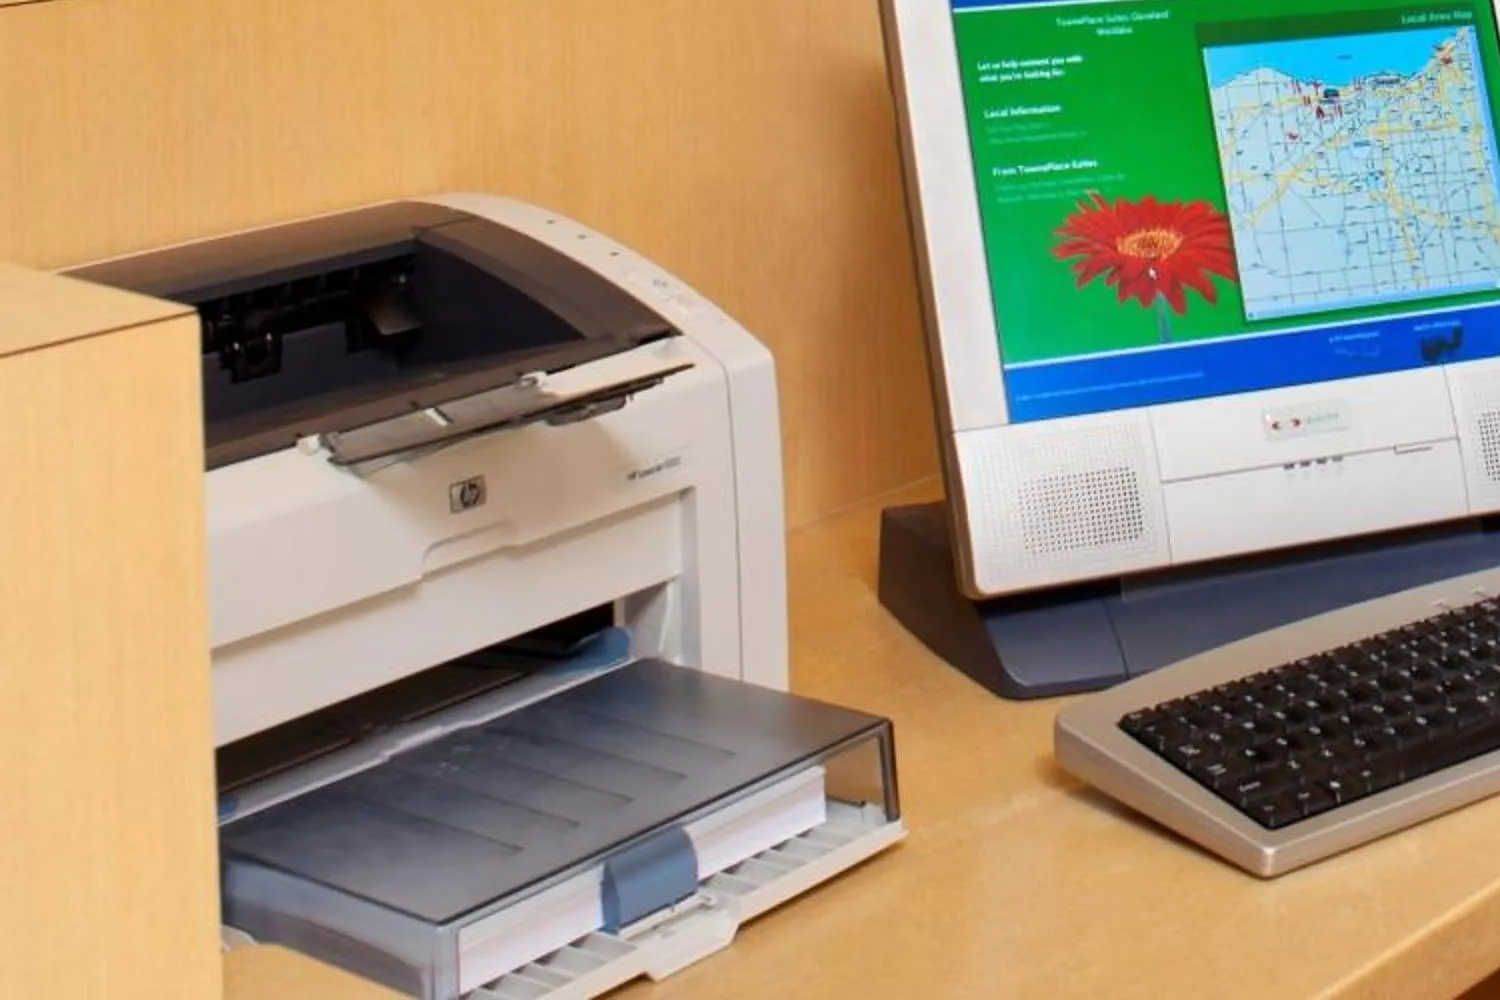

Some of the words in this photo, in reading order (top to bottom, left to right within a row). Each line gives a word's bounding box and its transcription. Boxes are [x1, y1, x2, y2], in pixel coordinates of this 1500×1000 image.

[1002, 58, 1018, 71] help
[984, 106, 1008, 119] Local
[1010, 102, 1062, 117] Information
[993, 164, 1016, 178] From
[1018, 161, 1070, 175] TownePlace
[1071, 158, 1098, 171] Suites
